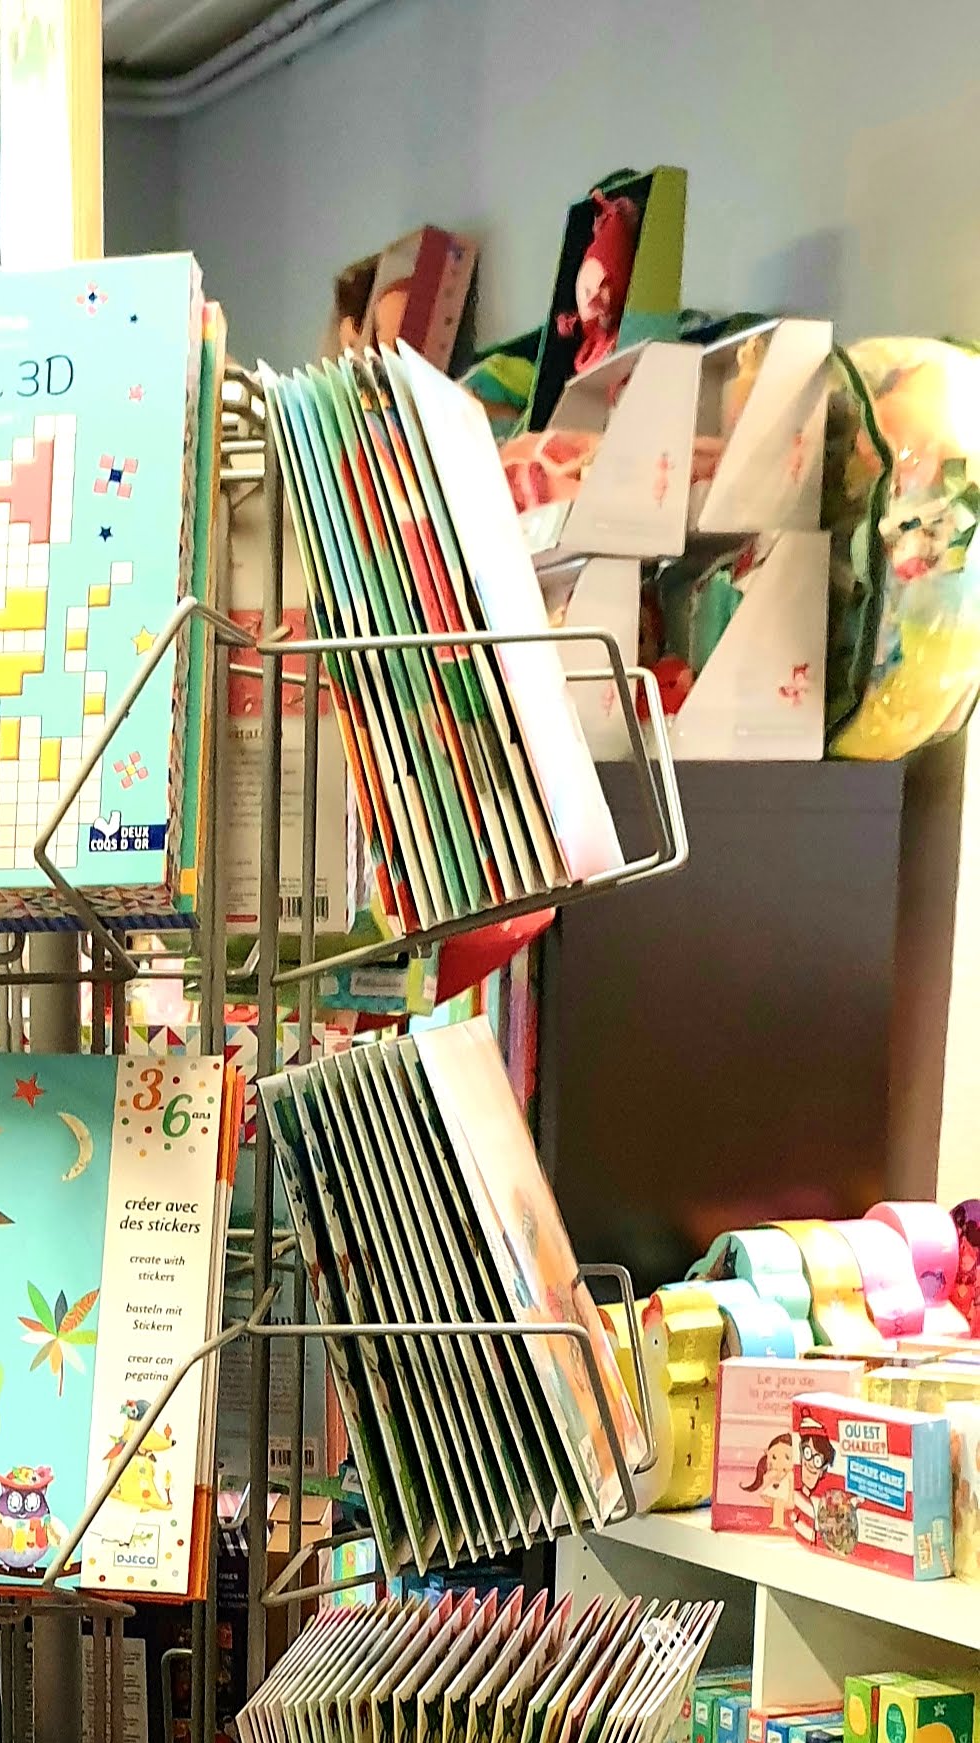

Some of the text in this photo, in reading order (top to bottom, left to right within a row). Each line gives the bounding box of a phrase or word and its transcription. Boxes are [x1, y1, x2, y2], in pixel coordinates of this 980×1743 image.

[16, 355, 74, 398] 3D
[120, 826, 150, 838] DEUX
[90, 838, 118, 851] COQS
[192, 1111, 211, 1120] ans
[125, 1197, 199, 1214] créer avec
[119, 1215, 201, 1234] des stickers
[130, 1255, 185, 1266] create with
[138, 1271, 175, 1282] stickers
[126, 1302, 183, 1316] basteln mit
[132, 1319, 173, 1332] Stickern
[127, 1355, 174, 1365] crear con
[124, 1371, 169, 1382] pegatina
[864, 1426, 880, 1439] EST
[116, 1554, 156, 1565] DJECO
